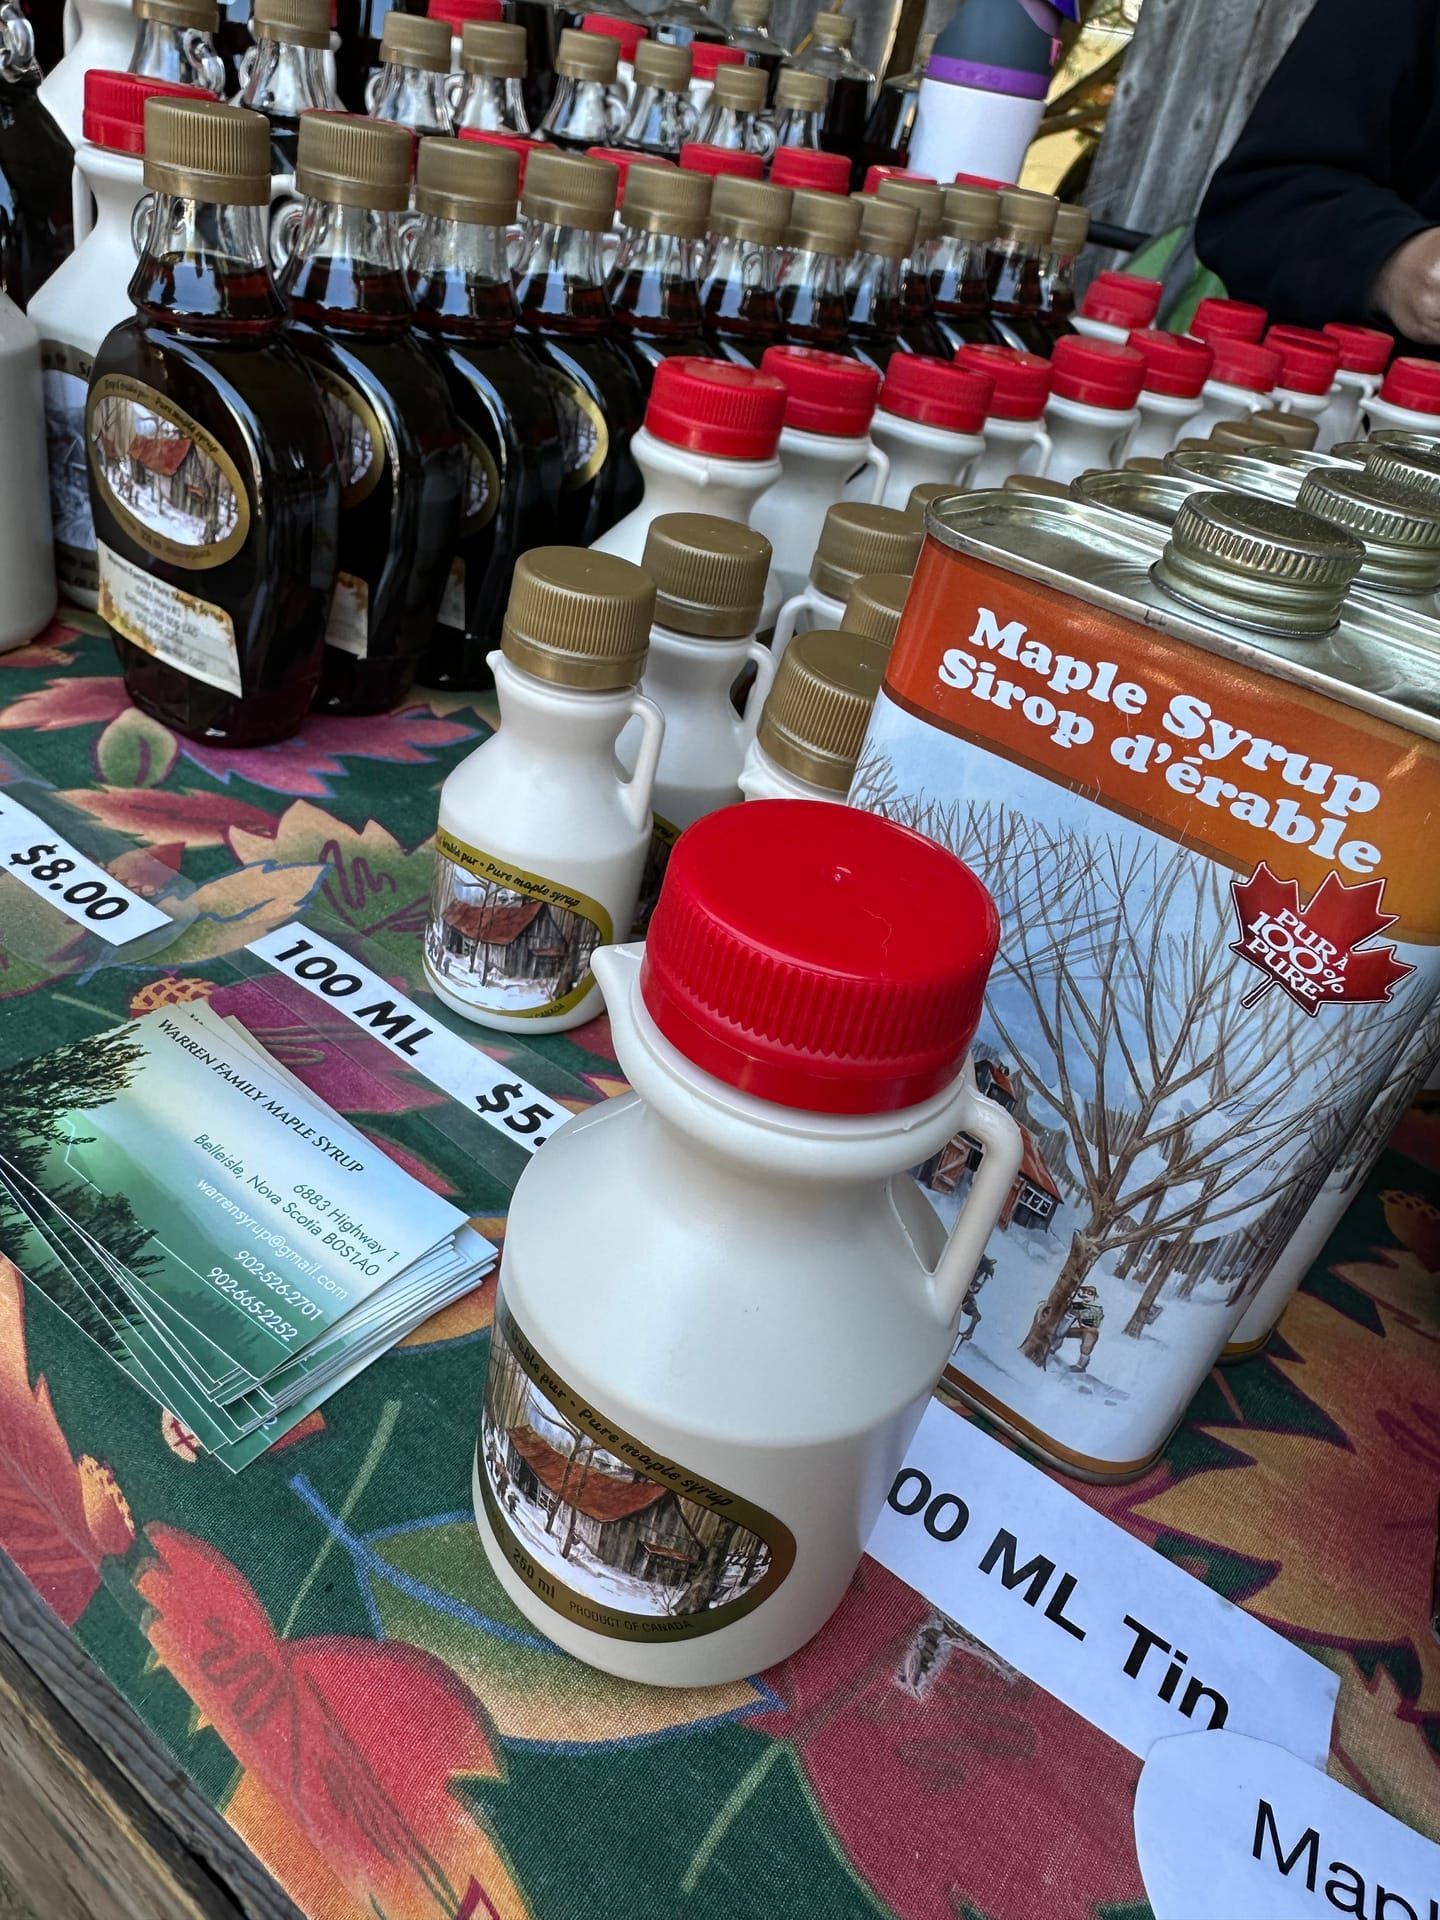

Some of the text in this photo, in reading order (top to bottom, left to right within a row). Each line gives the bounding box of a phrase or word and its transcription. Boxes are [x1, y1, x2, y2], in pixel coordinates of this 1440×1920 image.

[968, 607, 1381, 815] Maple Syrup
[938, 648, 1382, 874] Sirop d'érable
[8, 844, 130, 921] $8.00
[460, 852, 479, 866] pur
[486, 863, 512, 882] Pure
[514, 877, 550, 896] maple
[549, 890, 580, 908] syrup
[1246, 936, 1325, 1001] PURE
[1247, 911, 1347, 994] 100%
[1274, 908, 1338, 965] PUR
[274, 939, 555, 1148] 100 ML $5.
[158, 1018, 364, 1173] WARREN FAMILY MAPLE SYRUP
[193, 1133, 245, 1180] Belleisle,
[246, 1174, 282, 1206] Nova
[281, 1202, 322, 1236] Scotia
[293, 1183, 400, 1264] 6883 Highway 1
[197, 1178, 348, 1300] warrensyrup@gmail.com
[207, 1266, 298, 1342] 902-665-2252
[234, 1249, 323, 1322] 902-526-2701
[540, 1373, 566, 1399] pur
[579, 1408, 619, 1443] Pure
[620, 1442, 681, 1481] maple
[680, 1479, 733, 1507] syrup
[512, 1547, 556, 1600] 250 ml
[887, 1467, 1230, 1731] 00 ML Tin
[569, 1600, 695, 1633] PRODUCT OF CANADA
[1252, 1798, 1440, 1920] Ma
